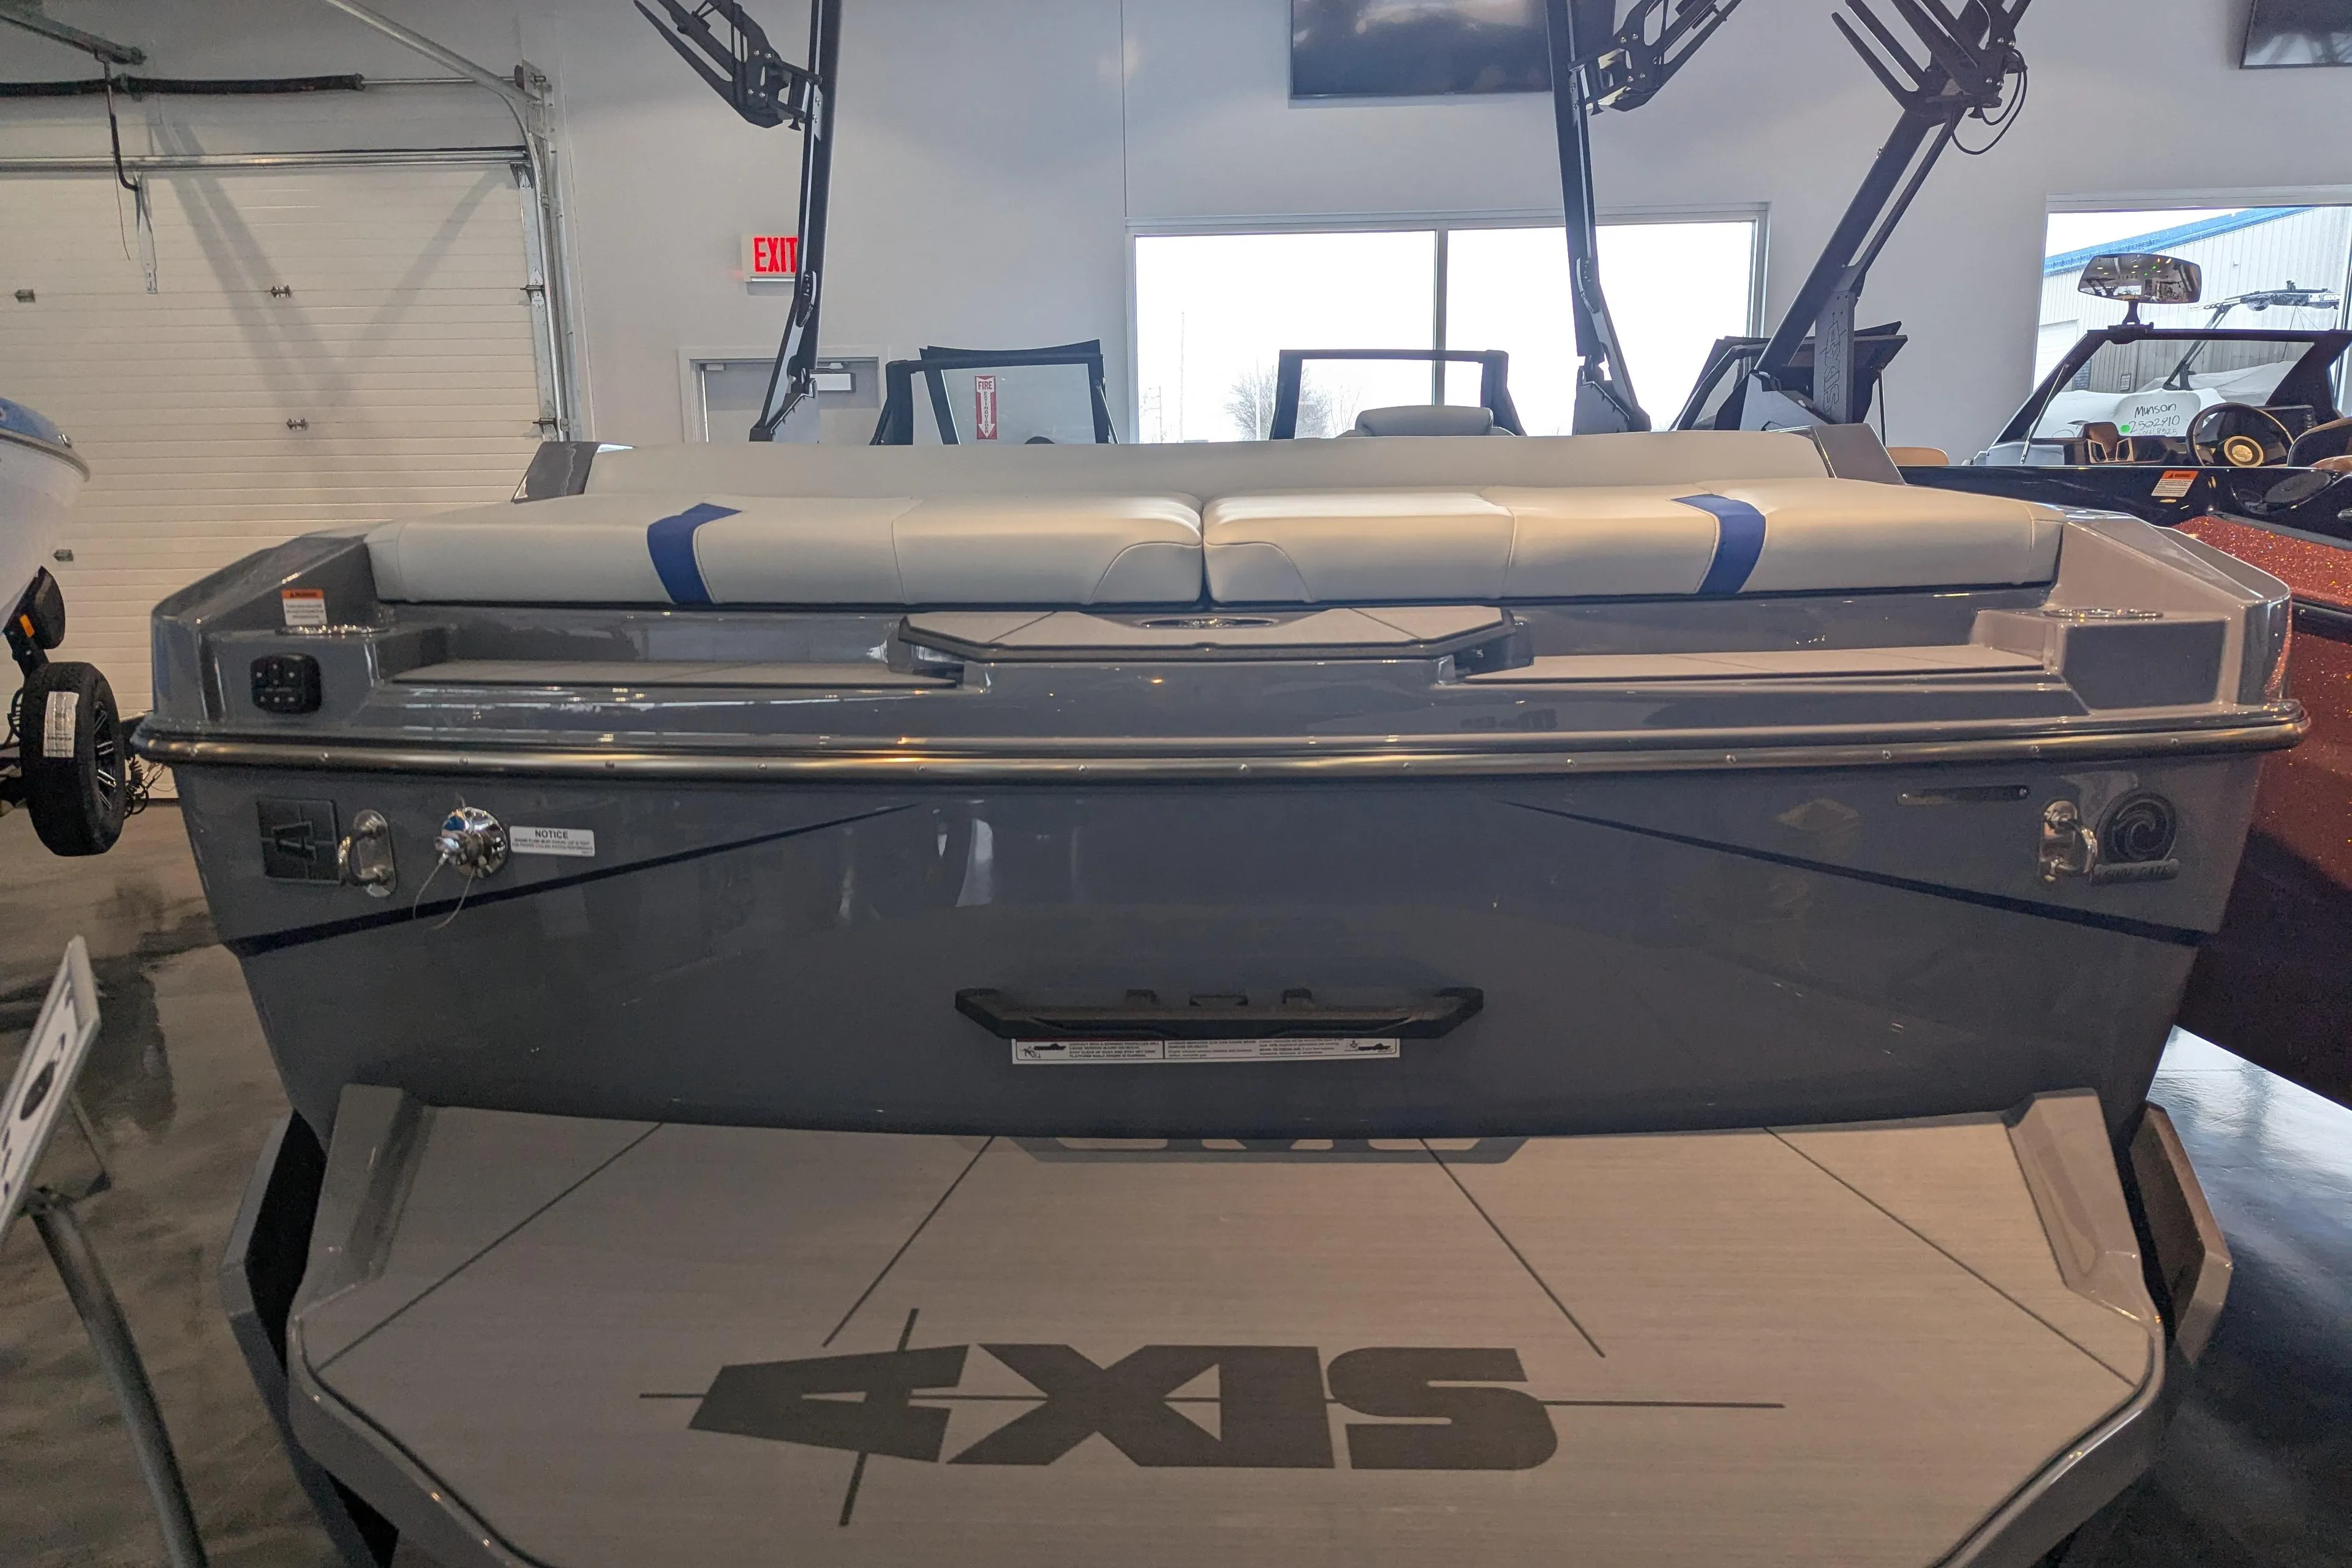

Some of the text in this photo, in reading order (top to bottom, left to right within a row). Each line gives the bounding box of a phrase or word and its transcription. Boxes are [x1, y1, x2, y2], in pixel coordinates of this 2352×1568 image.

[753, 237, 798, 273] EXIT
[978, 381, 993, 390] FIRE
[2134, 403, 2177, 418] Munson
[2128, 415, 2180, 433] 2502910
[535, 829, 569, 840] NOTICE
[687, 1343, 1558, 1471] AXIS
